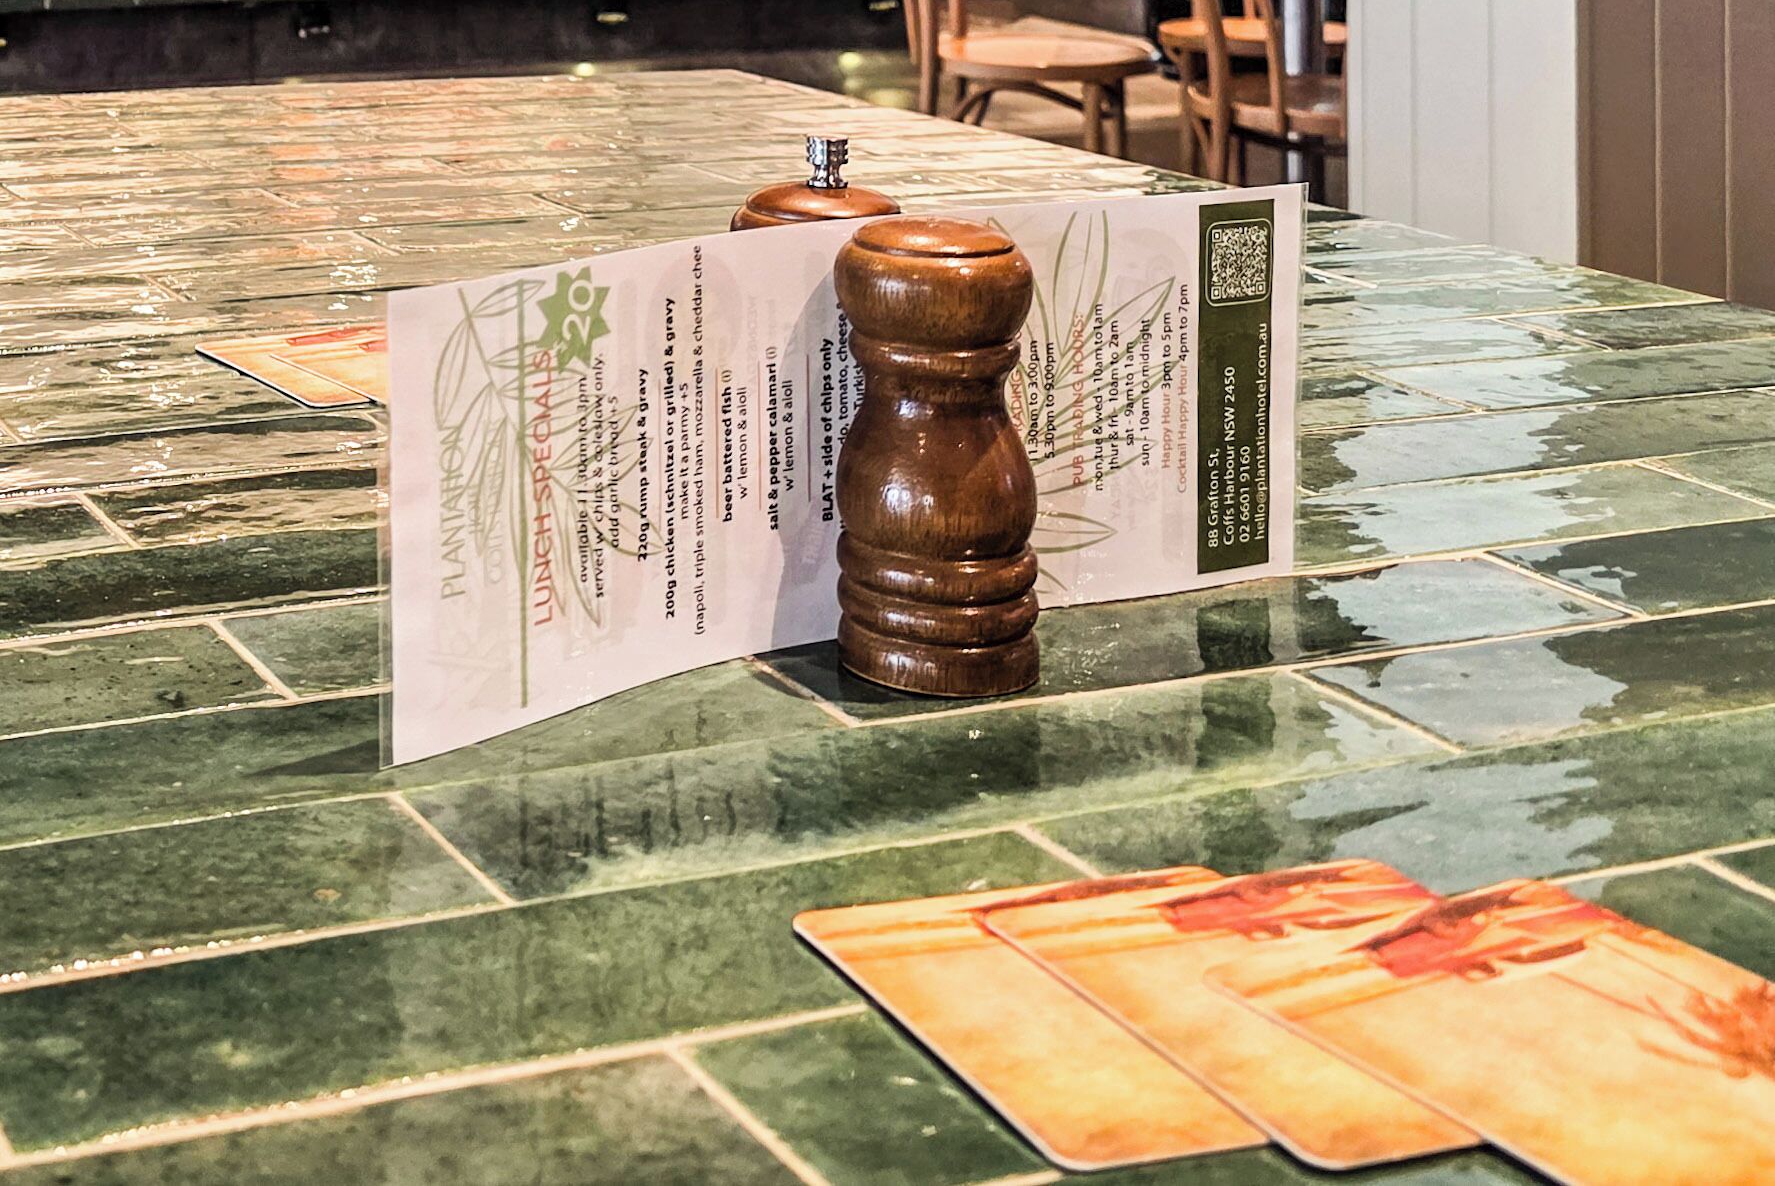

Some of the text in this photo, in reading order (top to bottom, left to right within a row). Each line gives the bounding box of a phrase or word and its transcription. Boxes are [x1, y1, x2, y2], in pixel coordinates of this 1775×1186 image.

[835, 314, 849, 362] cheese
[1108, 320, 1119, 346] 2am
[1124, 342, 1135, 368] 1am
[1139, 319, 1152, 376] midnight
[1092, 348, 1104, 382] 10am
[1109, 352, 1120, 364] to
[1125, 373, 1134, 385] to
[577, 377, 589, 411] 3pm
[679, 383, 689, 401] +5
[721, 387, 732, 414] fish
[766, 363, 778, 427] calamari
[838, 365, 849, 419] tomato,
[1011, 369, 1023, 438] RADING
[1026, 340, 1040, 461] 11.30am to 3.00pm
[1043, 342, 1056, 458] 5.30pm to 9.00pm
[1073, 314, 1083, 485] PUB TRADING HOURS:
[1108, 368, 1119, 402] 10am
[1124, 389, 1135, 416] 9am
[1140, 381, 1150, 393] to
[1161, 312, 1172, 468] Happy Hour 3pm to 5pm
[1178, 285, 1189, 493] Cocktail Happy Hour 4pm to 7pm
[578, 418, 588, 432] to
[593, 394, 604, 461] coleslaw
[681, 406, 691, 451] parmy
[819, 339, 835, 522] BLAT + side of chips only
[1092, 396, 1104, 422] wed
[1139, 397, 1150, 431] 10am
[1254, 323, 1268, 540] hello@plantationhotel.com.au
[608, 421, 619, 463] bread
[692, 246, 706, 634] (napoli, triple smoked ham, mozzarella & cheddar chee
[721, 418, 733, 484] battered
[736, 387, 748, 499] w' lemon & aioli
[781, 380, 794, 491] w' lemon & aioli
[1108, 431, 1119, 439] &
[1108, 443, 1119, 469] thur
[1125, 428, 1134, 446] sat
[1141, 444, 1150, 466] sun
[1222, 367, 1236, 545] Coffs Harbour NSW 2450
[593, 466, 602, 477] &
[636, 369, 650, 562] 220g rump steak & gravy
[663, 298, 677, 619] 200g chicken (schnitzel or grilled) & gravy
[769, 431, 781, 485] pepper
[533, 350, 552, 625] LUNCH SPECIALS
[593, 482, 605, 522] chips
[607, 468, 621, 513] garlic
[679, 481, 689, 519] make
[722, 488, 733, 522] beer
[767, 489, 778, 499] &
[1207, 448, 1221, 547] 88 Grafton St,
[1239, 446, 1251, 542] 02 6601 9160
[440, 424, 465, 600] PLANTATION
[608, 518, 620, 547] add
[767, 504, 779, 530] salt
[577, 511, 589, 582] available
[593, 549, 604, 598] served
